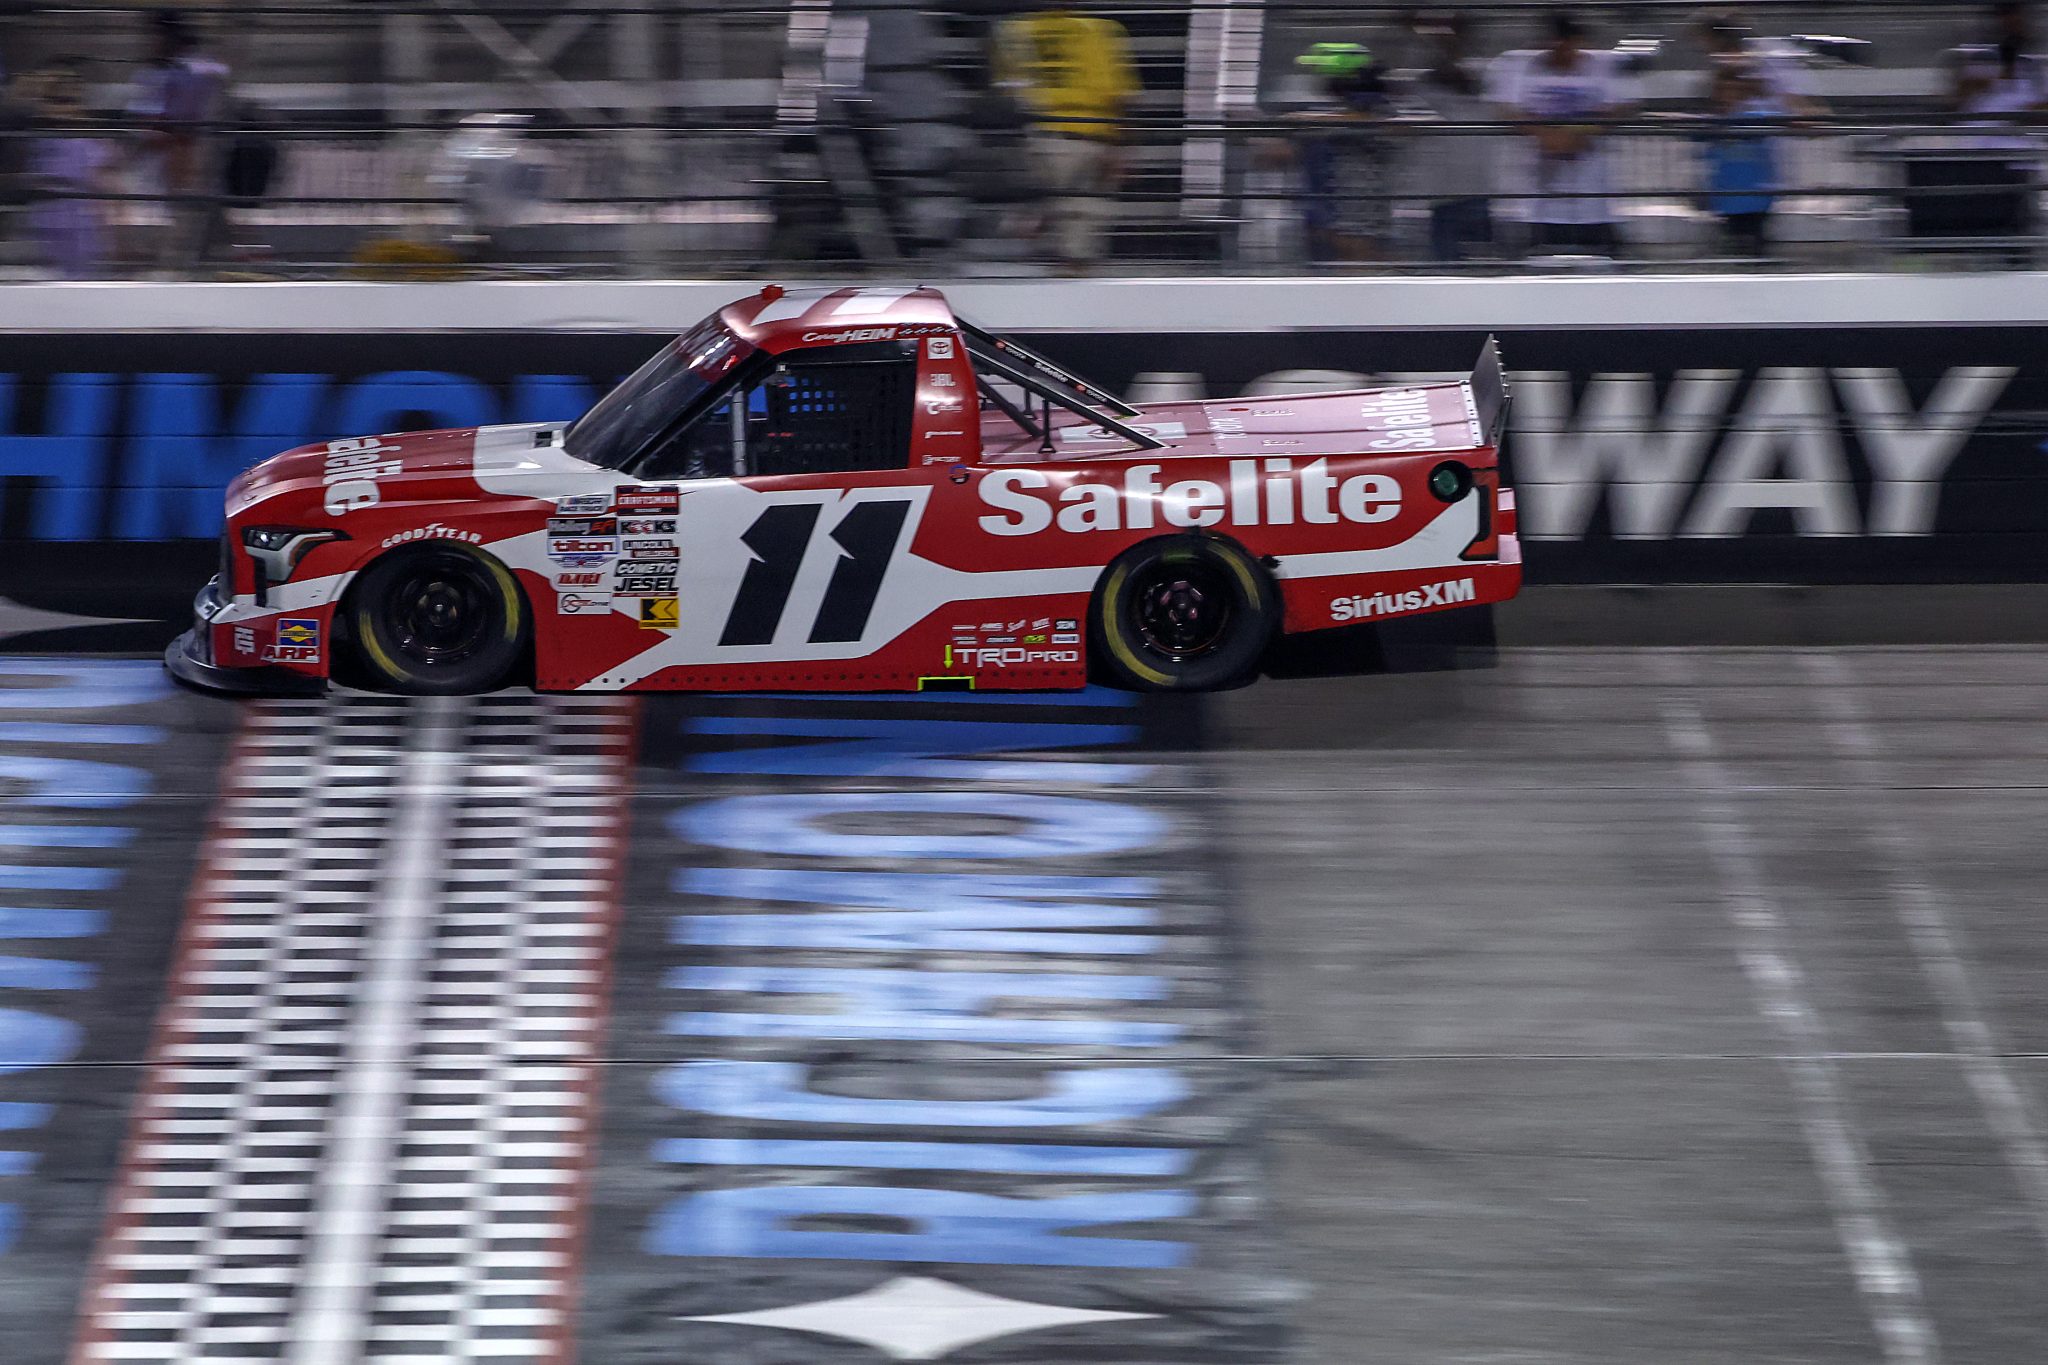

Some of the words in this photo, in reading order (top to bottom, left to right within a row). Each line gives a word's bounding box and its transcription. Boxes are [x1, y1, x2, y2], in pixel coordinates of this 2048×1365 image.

[843, 328, 897, 342] HEIM
[1361, 389, 1437, 448] Safelite
[322, 433, 404, 516] afelite
[978, 457, 1402, 536] Safelite
[381, 522, 482, 548] GOODYEAR
[613, 578, 678, 592] JESEL
[617, 563, 677, 574] COMETIC
[717, 499, 913, 646] 11
[1330, 577, 1476, 621] SiriusXM
[640, 690, 1197, 1270] RICHMON
